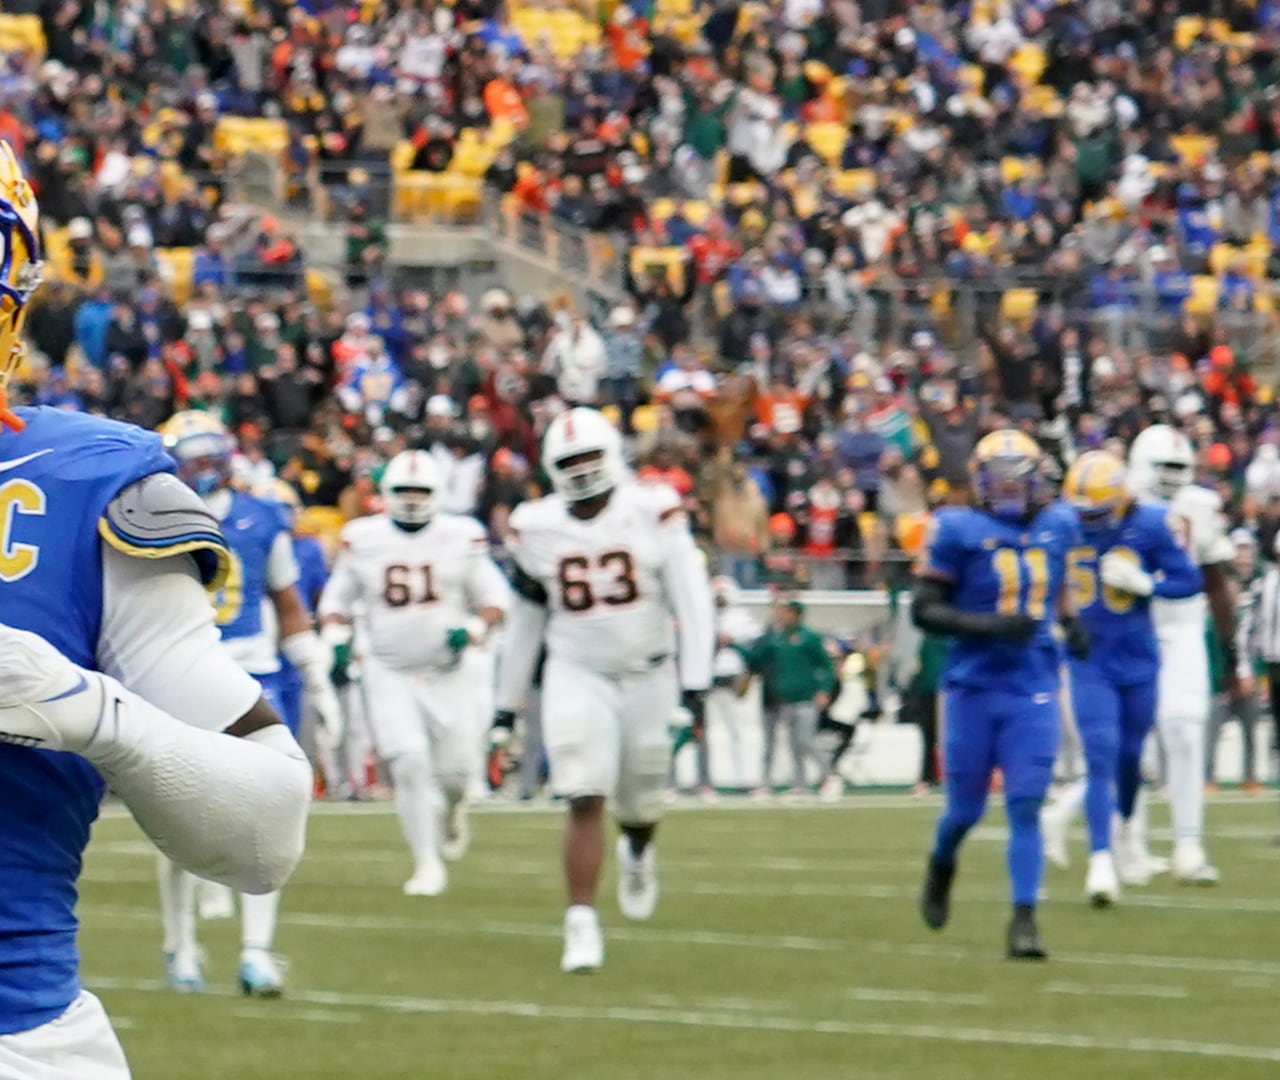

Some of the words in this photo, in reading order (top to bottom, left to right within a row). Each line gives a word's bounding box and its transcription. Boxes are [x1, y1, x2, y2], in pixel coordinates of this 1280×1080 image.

[385, 563, 438, 607] 61
[561, 551, 640, 611] 63
[992, 547, 1048, 620] 11
